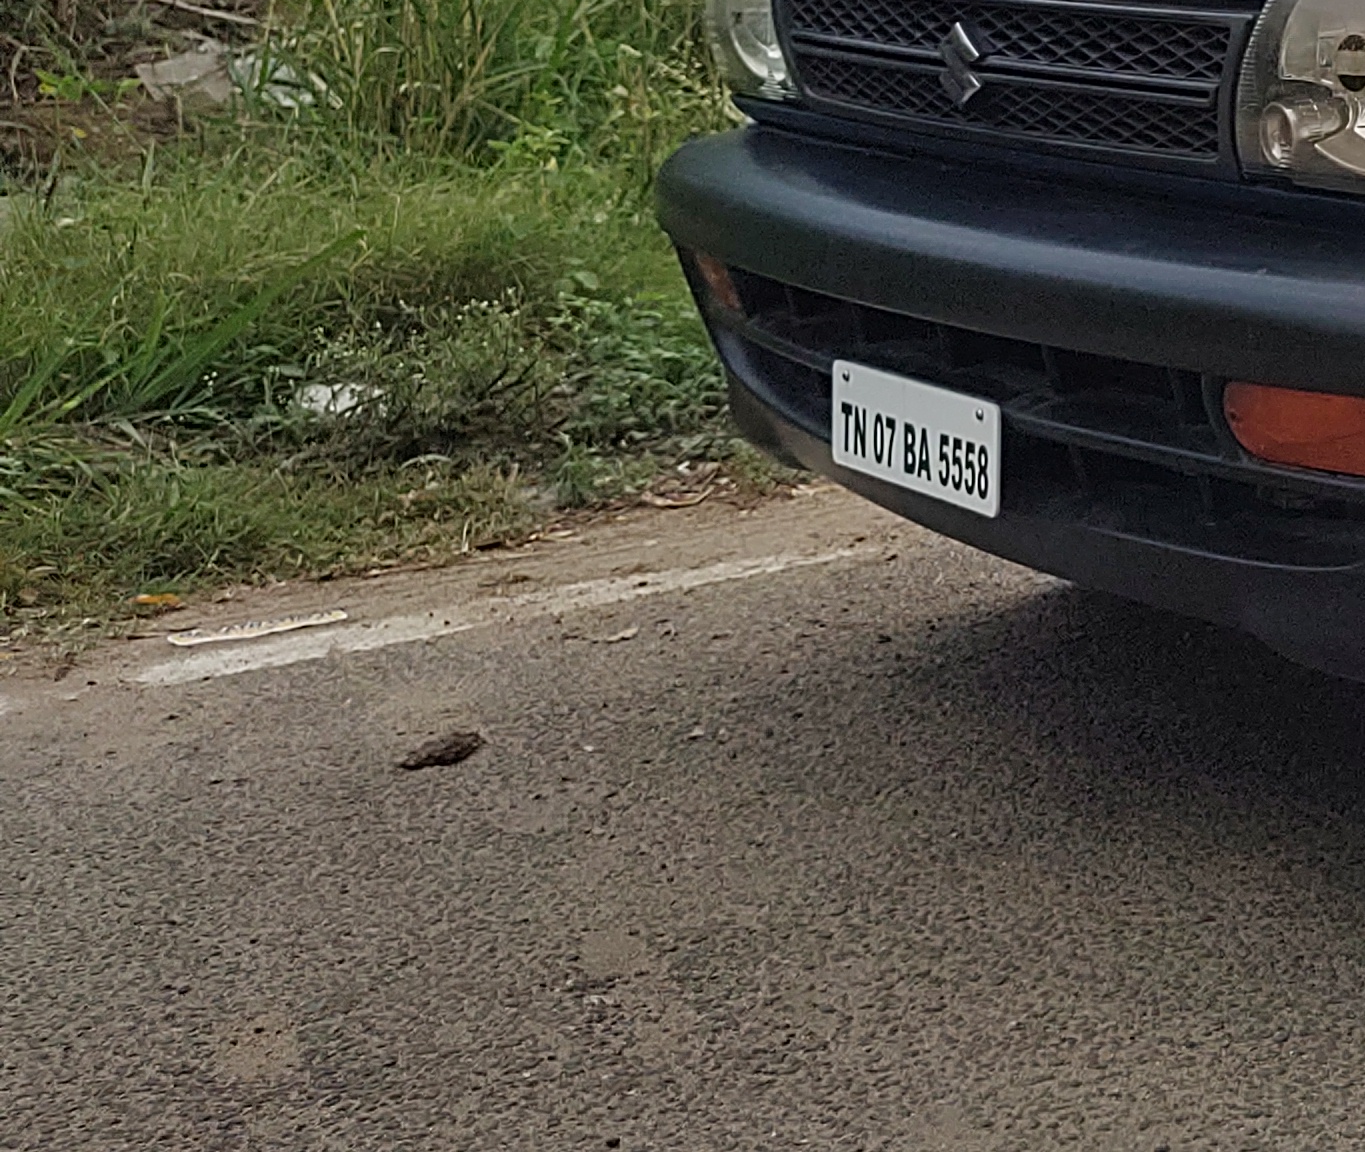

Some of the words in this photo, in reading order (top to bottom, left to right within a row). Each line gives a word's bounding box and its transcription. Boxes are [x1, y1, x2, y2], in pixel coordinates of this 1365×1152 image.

[841, 401, 867, 458] TN
[873, 413, 896, 468] 07
[904, 422, 931, 481] BA
[938, 433, 989, 499] 5558
